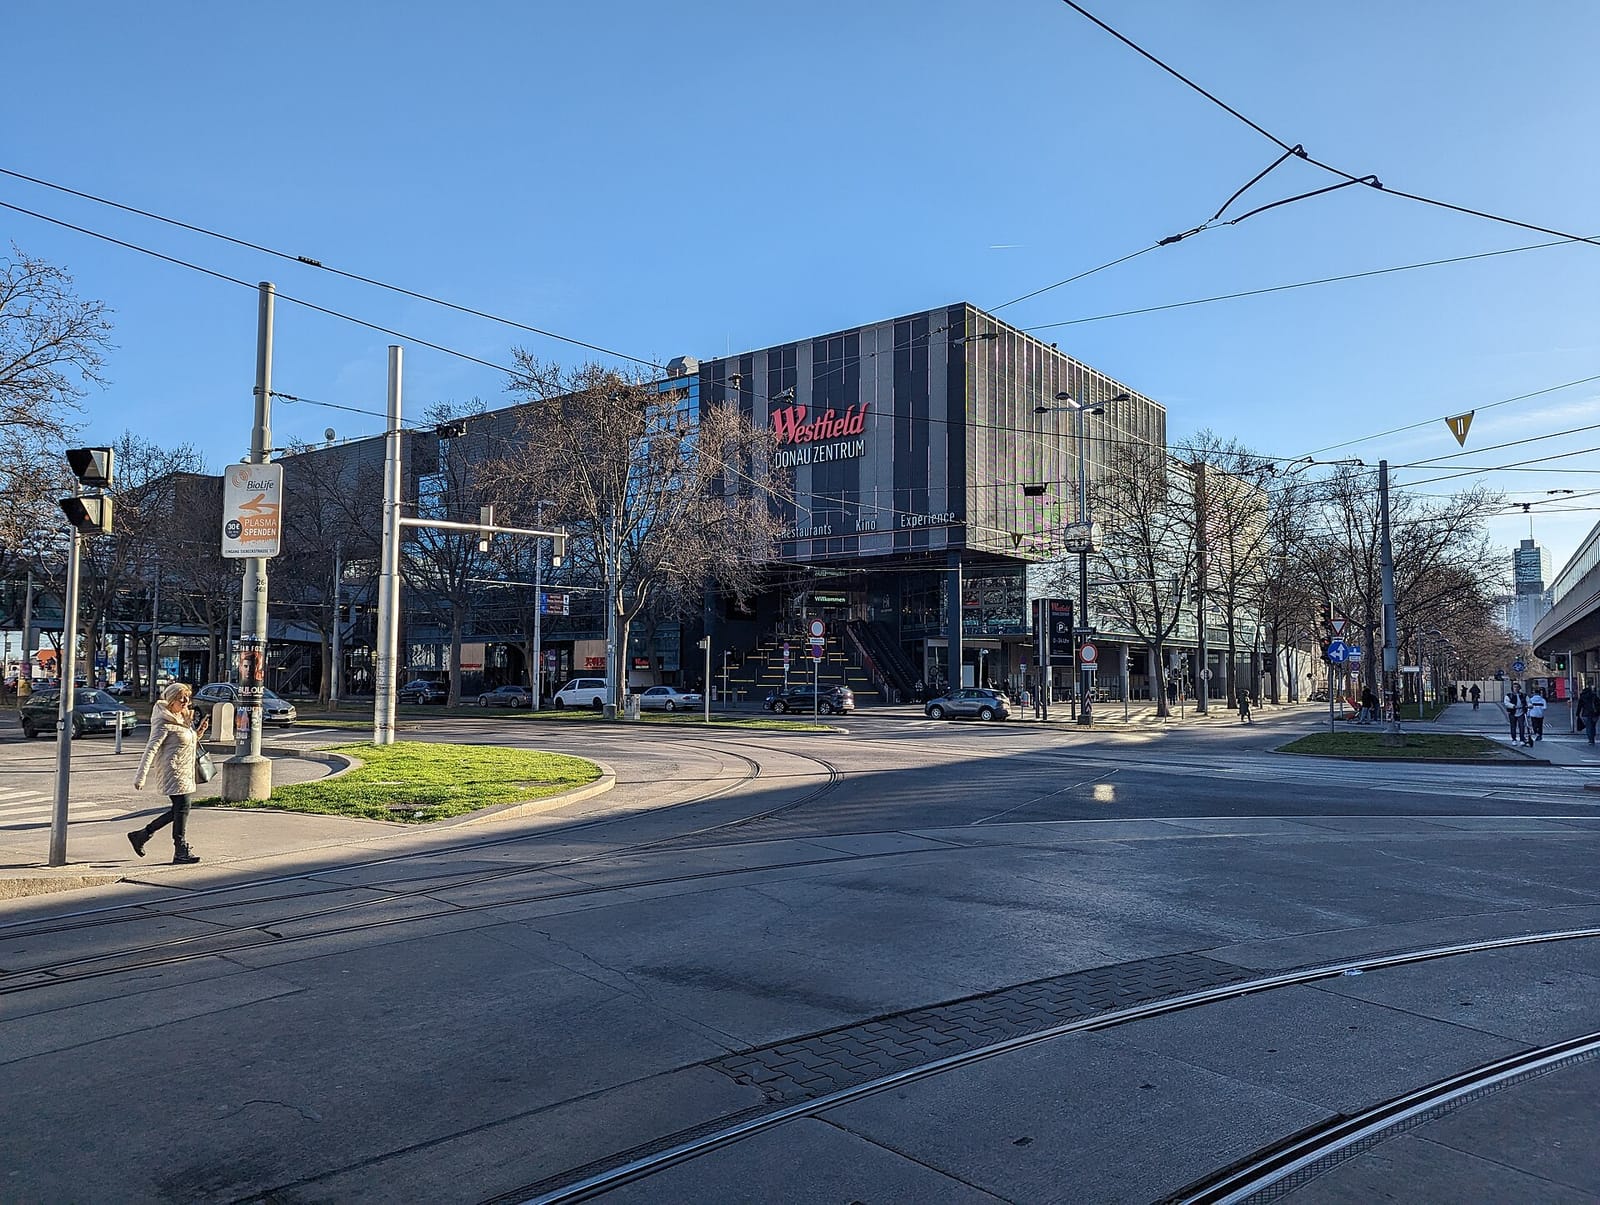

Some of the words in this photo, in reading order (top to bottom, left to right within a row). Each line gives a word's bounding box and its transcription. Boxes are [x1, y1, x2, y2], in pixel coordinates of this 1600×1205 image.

[771, 402, 870, 445] Westfield
[775, 447, 811, 469] DONAU
[813, 439, 865, 463] ZENTRUM
[246, 480, 274, 490] BioLife
[244, 518, 277, 527] PLASMA
[900, 511, 955, 528] Experience
[855, 519, 876, 532] Kino
[244, 528, 276, 536] SPENDEN
[814, 595, 846, 603] Willkommen
